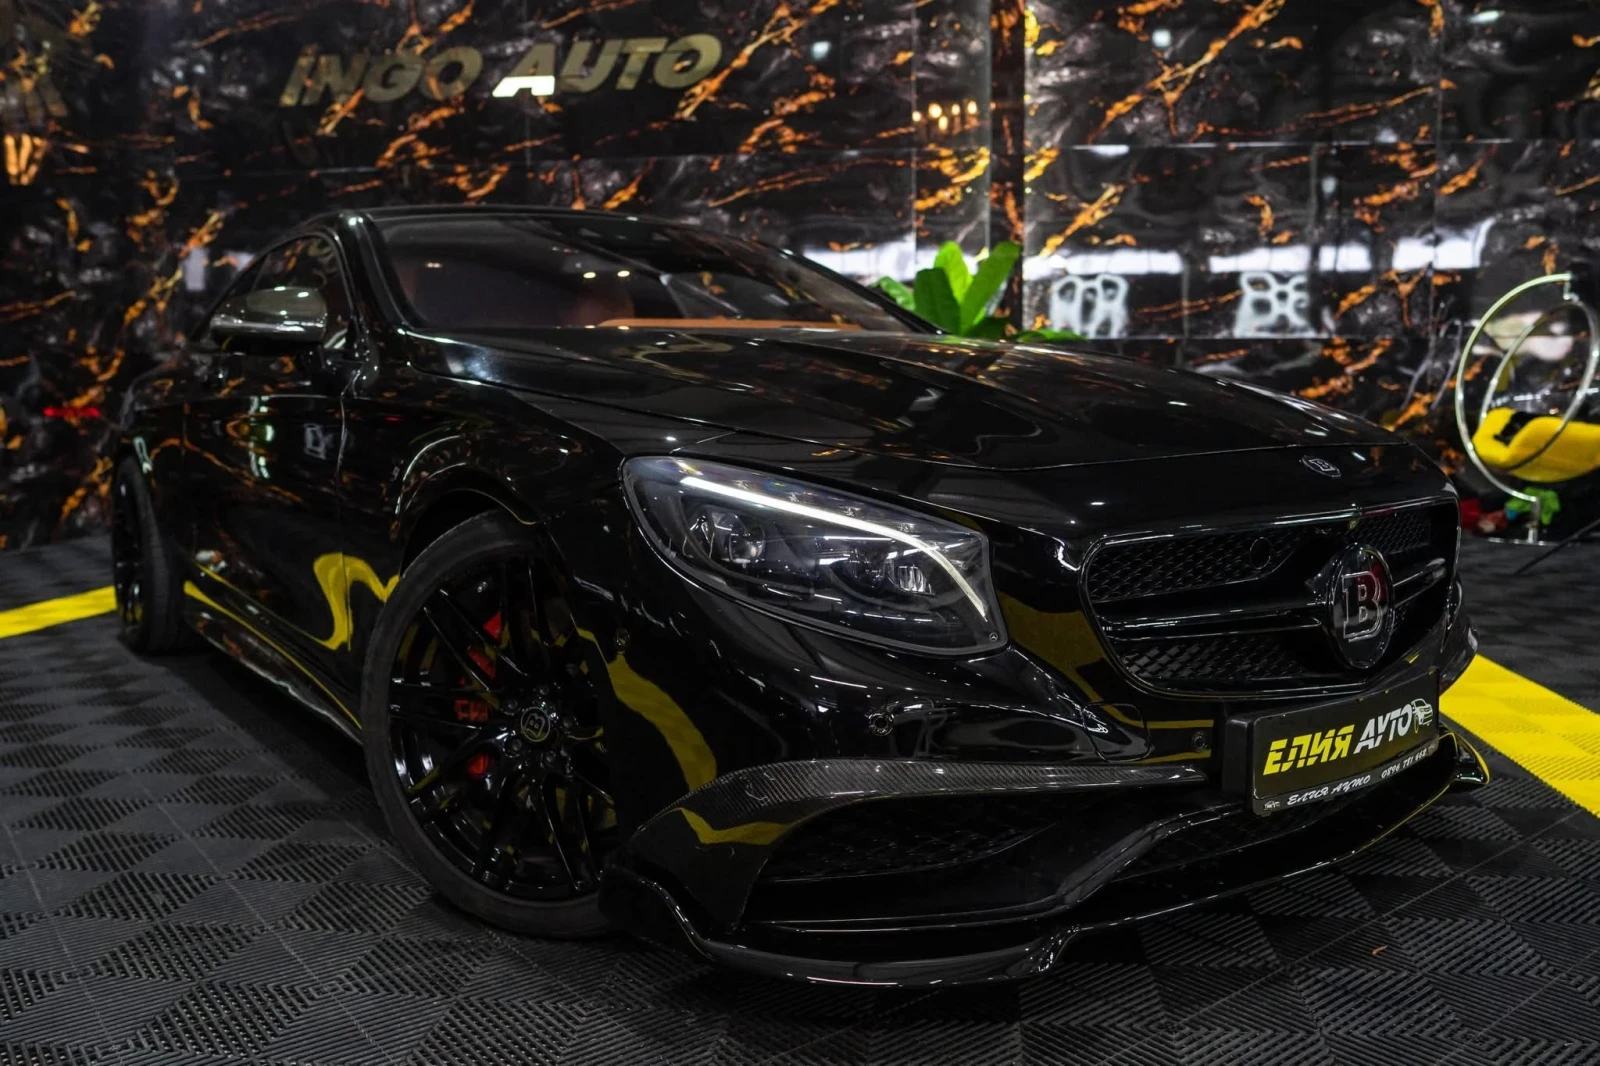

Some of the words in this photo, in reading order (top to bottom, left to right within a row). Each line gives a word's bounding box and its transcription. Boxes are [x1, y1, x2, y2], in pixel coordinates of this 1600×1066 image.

[279, 45, 484, 107] INGO
[492, 34, 722, 98] AUTO
[1341, 570, 1382, 642] B
[1263, 724, 1355, 776] ЕЛИЯ
